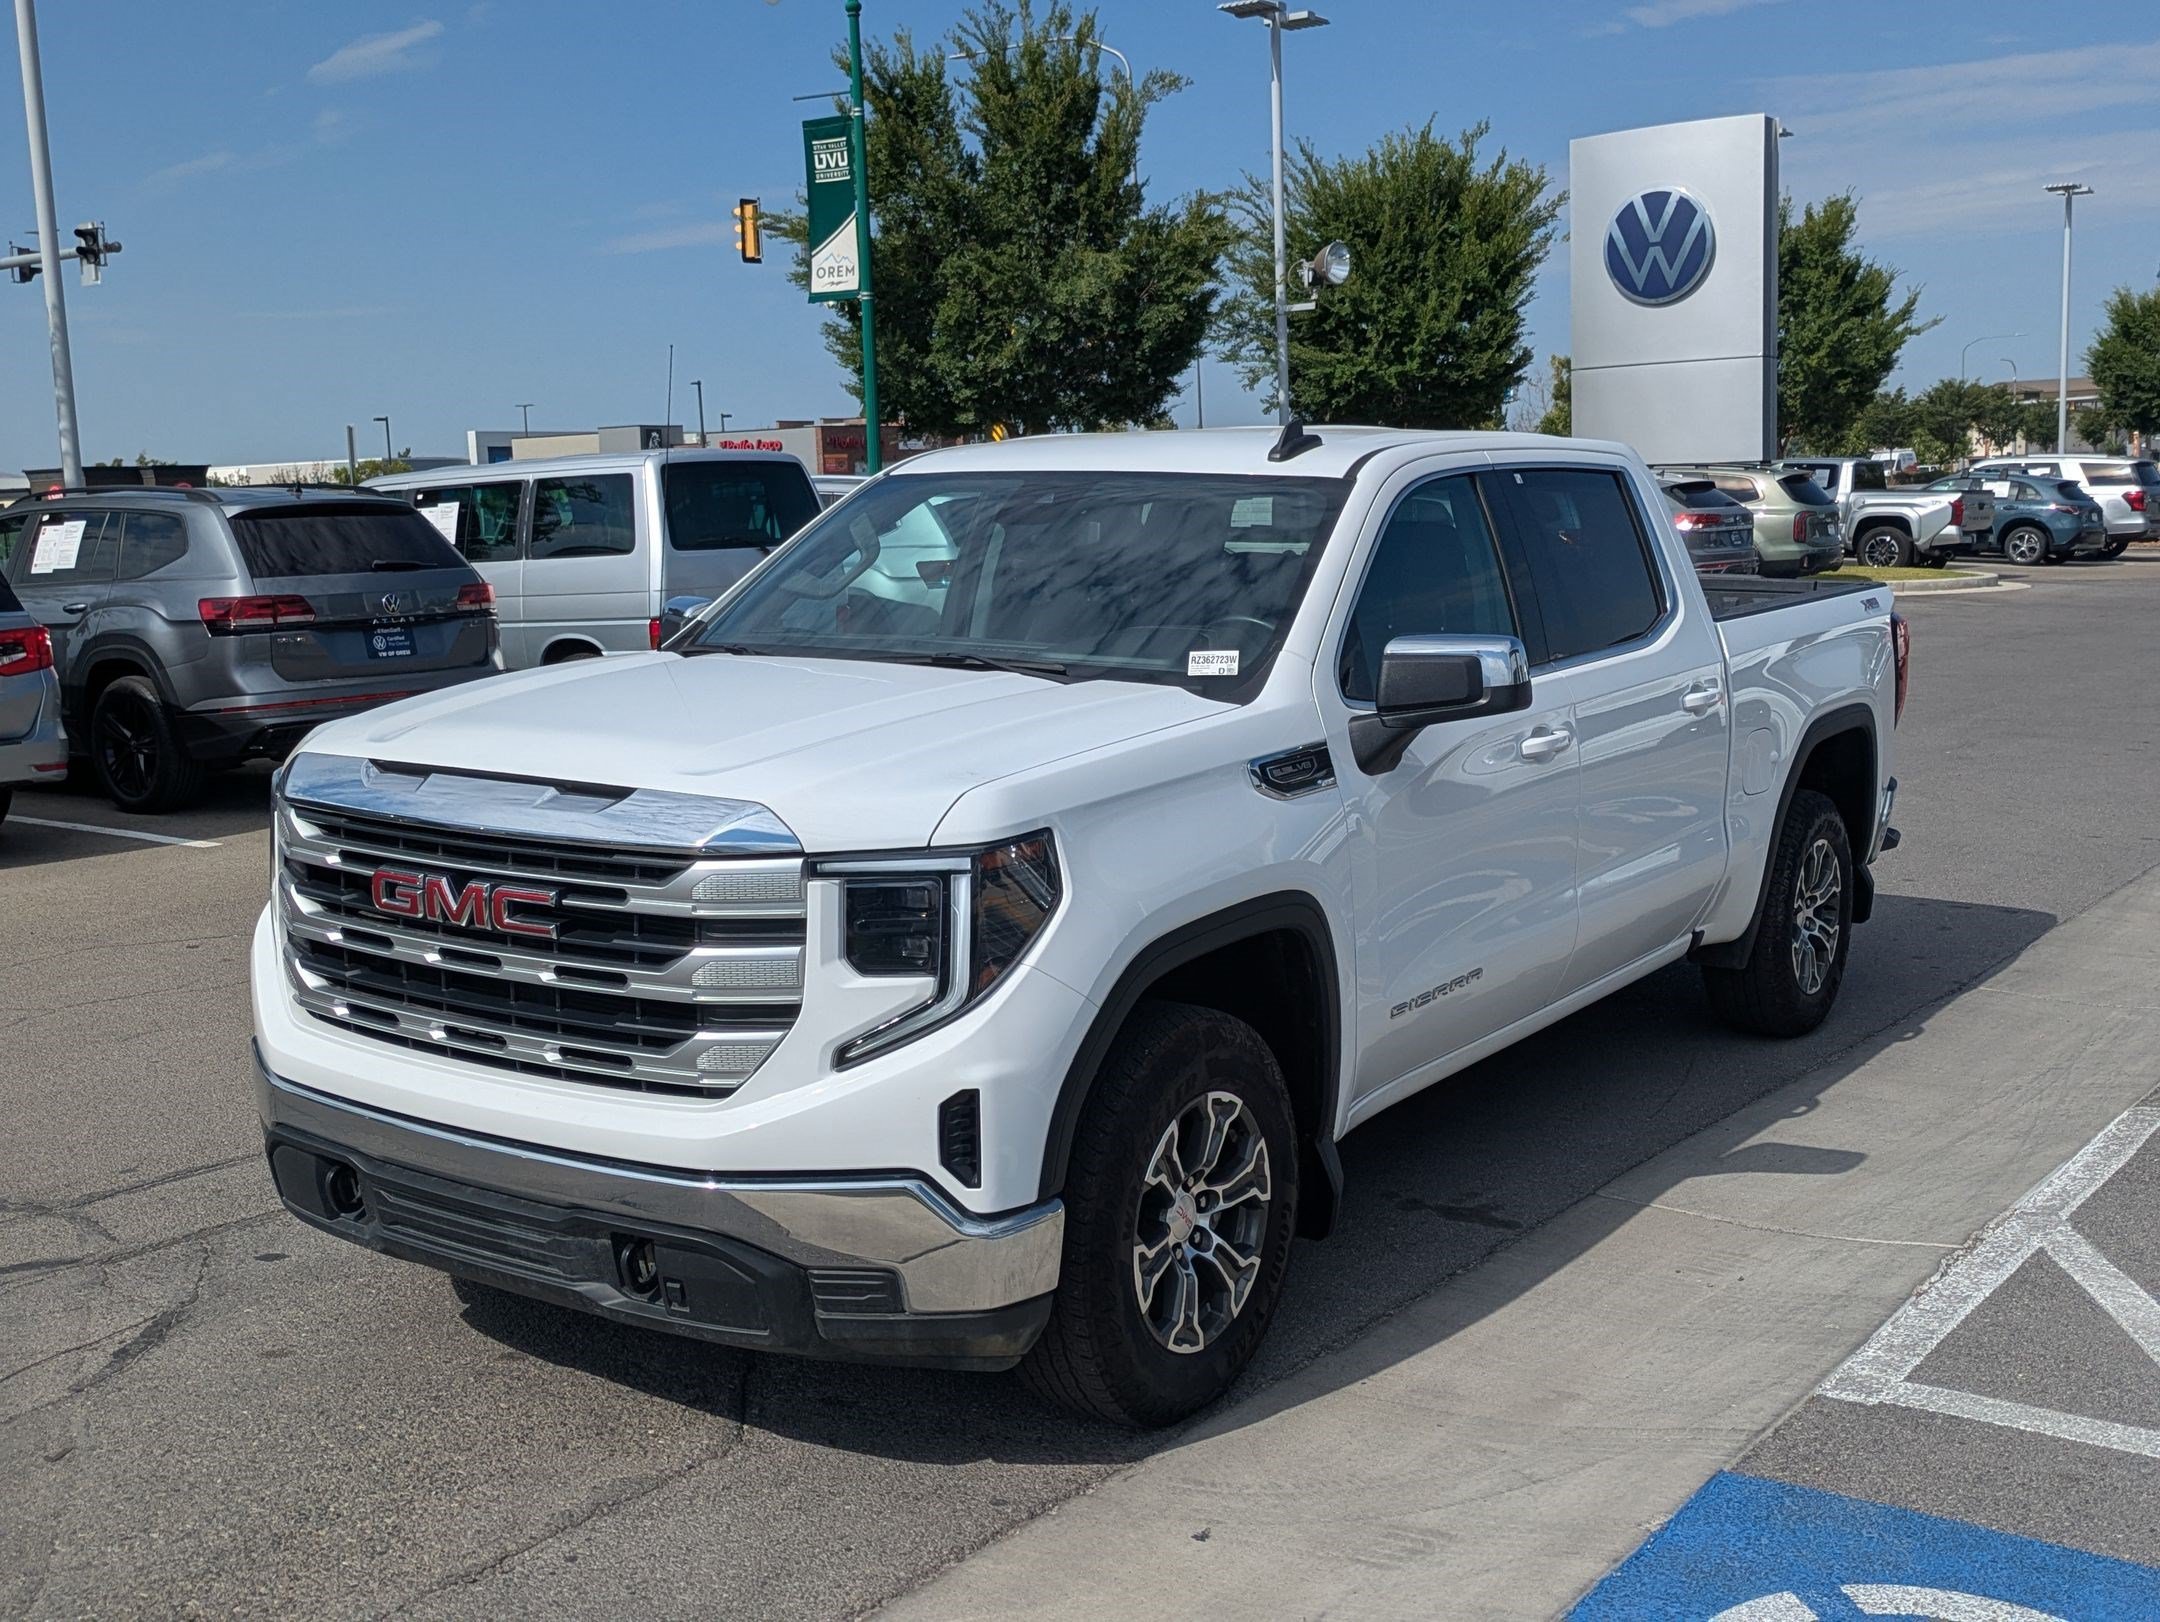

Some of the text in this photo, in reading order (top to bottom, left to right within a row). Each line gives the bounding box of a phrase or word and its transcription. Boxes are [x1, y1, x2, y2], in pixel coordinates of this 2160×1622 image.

[828, 141, 847, 150] VALLEY
[814, 150, 849, 169] UVU
[815, 171, 850, 180] UNIVERSITY
[816, 264, 855, 279] OREM
[372, 616, 415, 624] ATLAS
[1190, 655, 1238, 665] RZ362723W
[372, 867, 559, 940] GMC
[1390, 967, 1484, 1019] SIERRA
